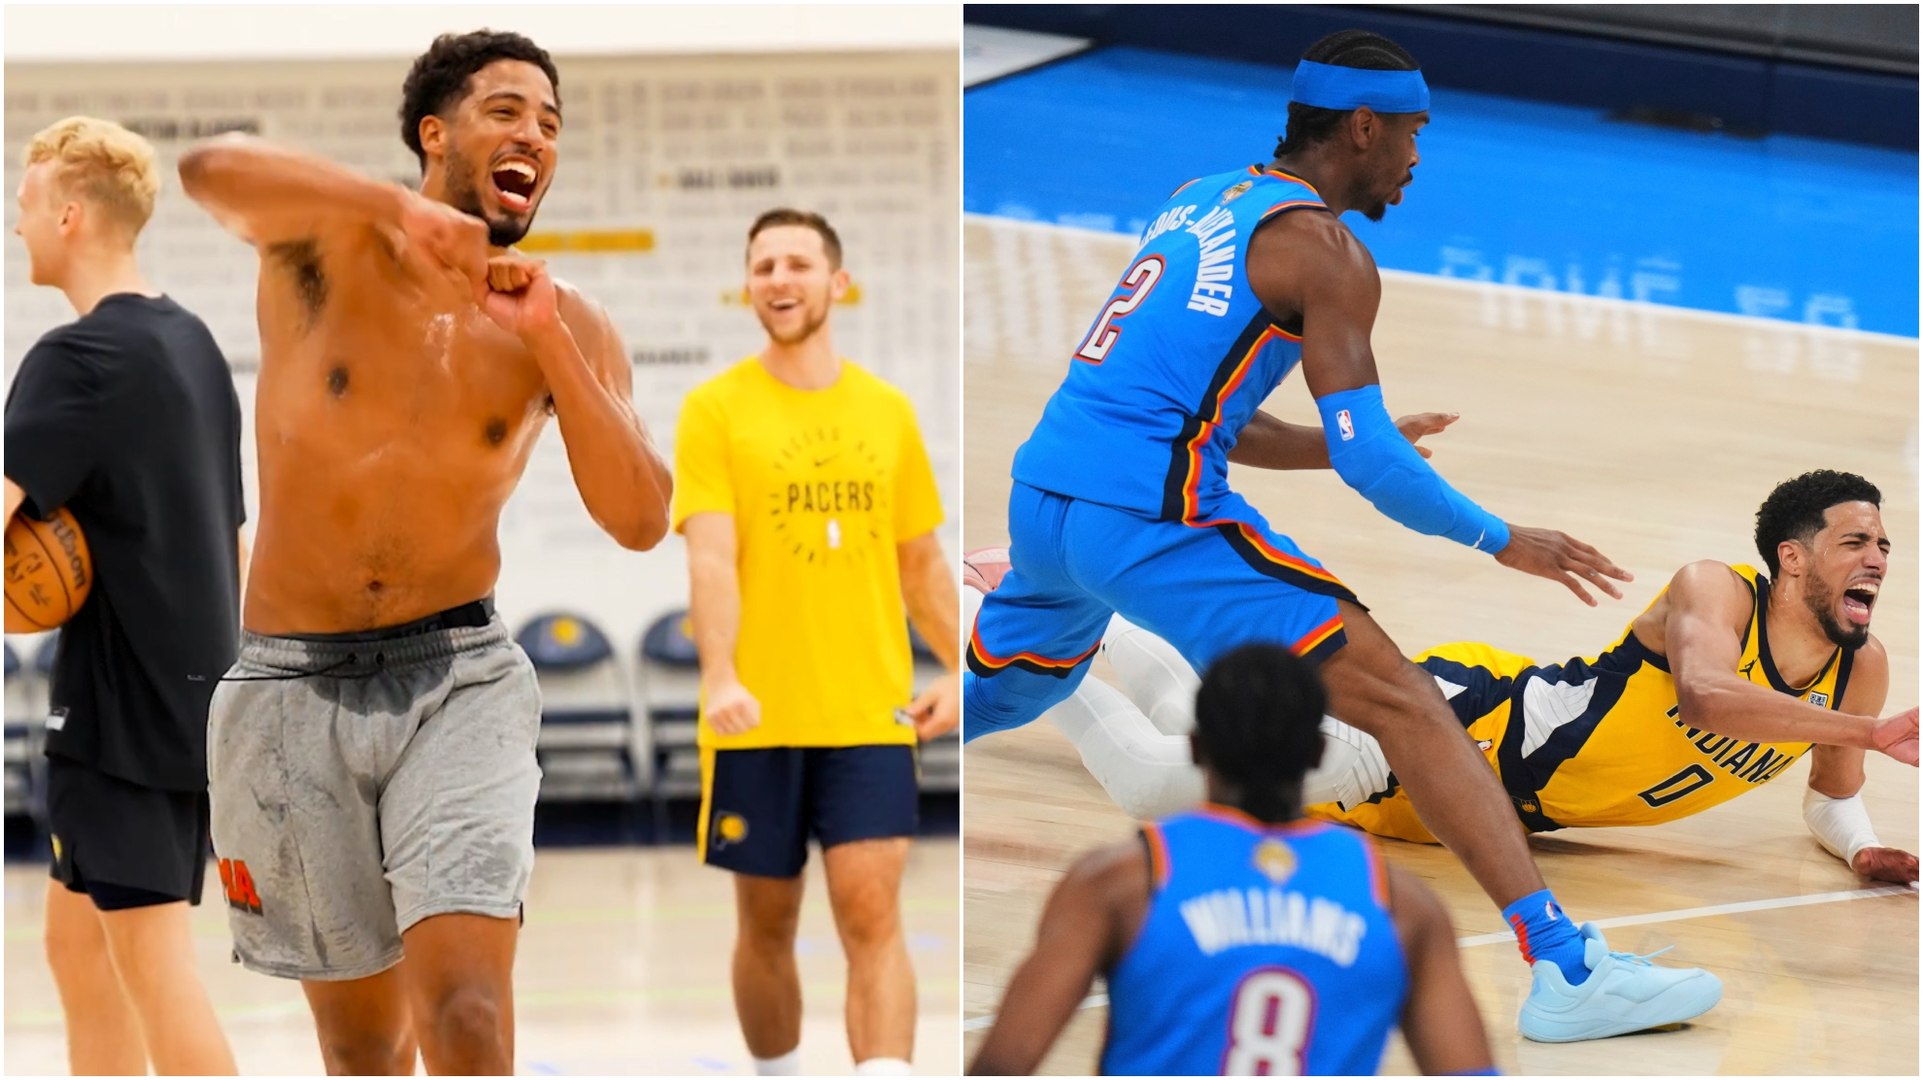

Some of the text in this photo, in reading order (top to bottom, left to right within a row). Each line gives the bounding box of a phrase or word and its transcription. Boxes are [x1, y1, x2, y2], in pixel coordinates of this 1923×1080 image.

[1073, 254, 1167, 365] 2
[787, 481, 875, 513] PACERS
[1637, 763, 1716, 807] 0
[1179, 886, 1367, 967] WILLIAMS
[1219, 964, 1319, 1076] 8
